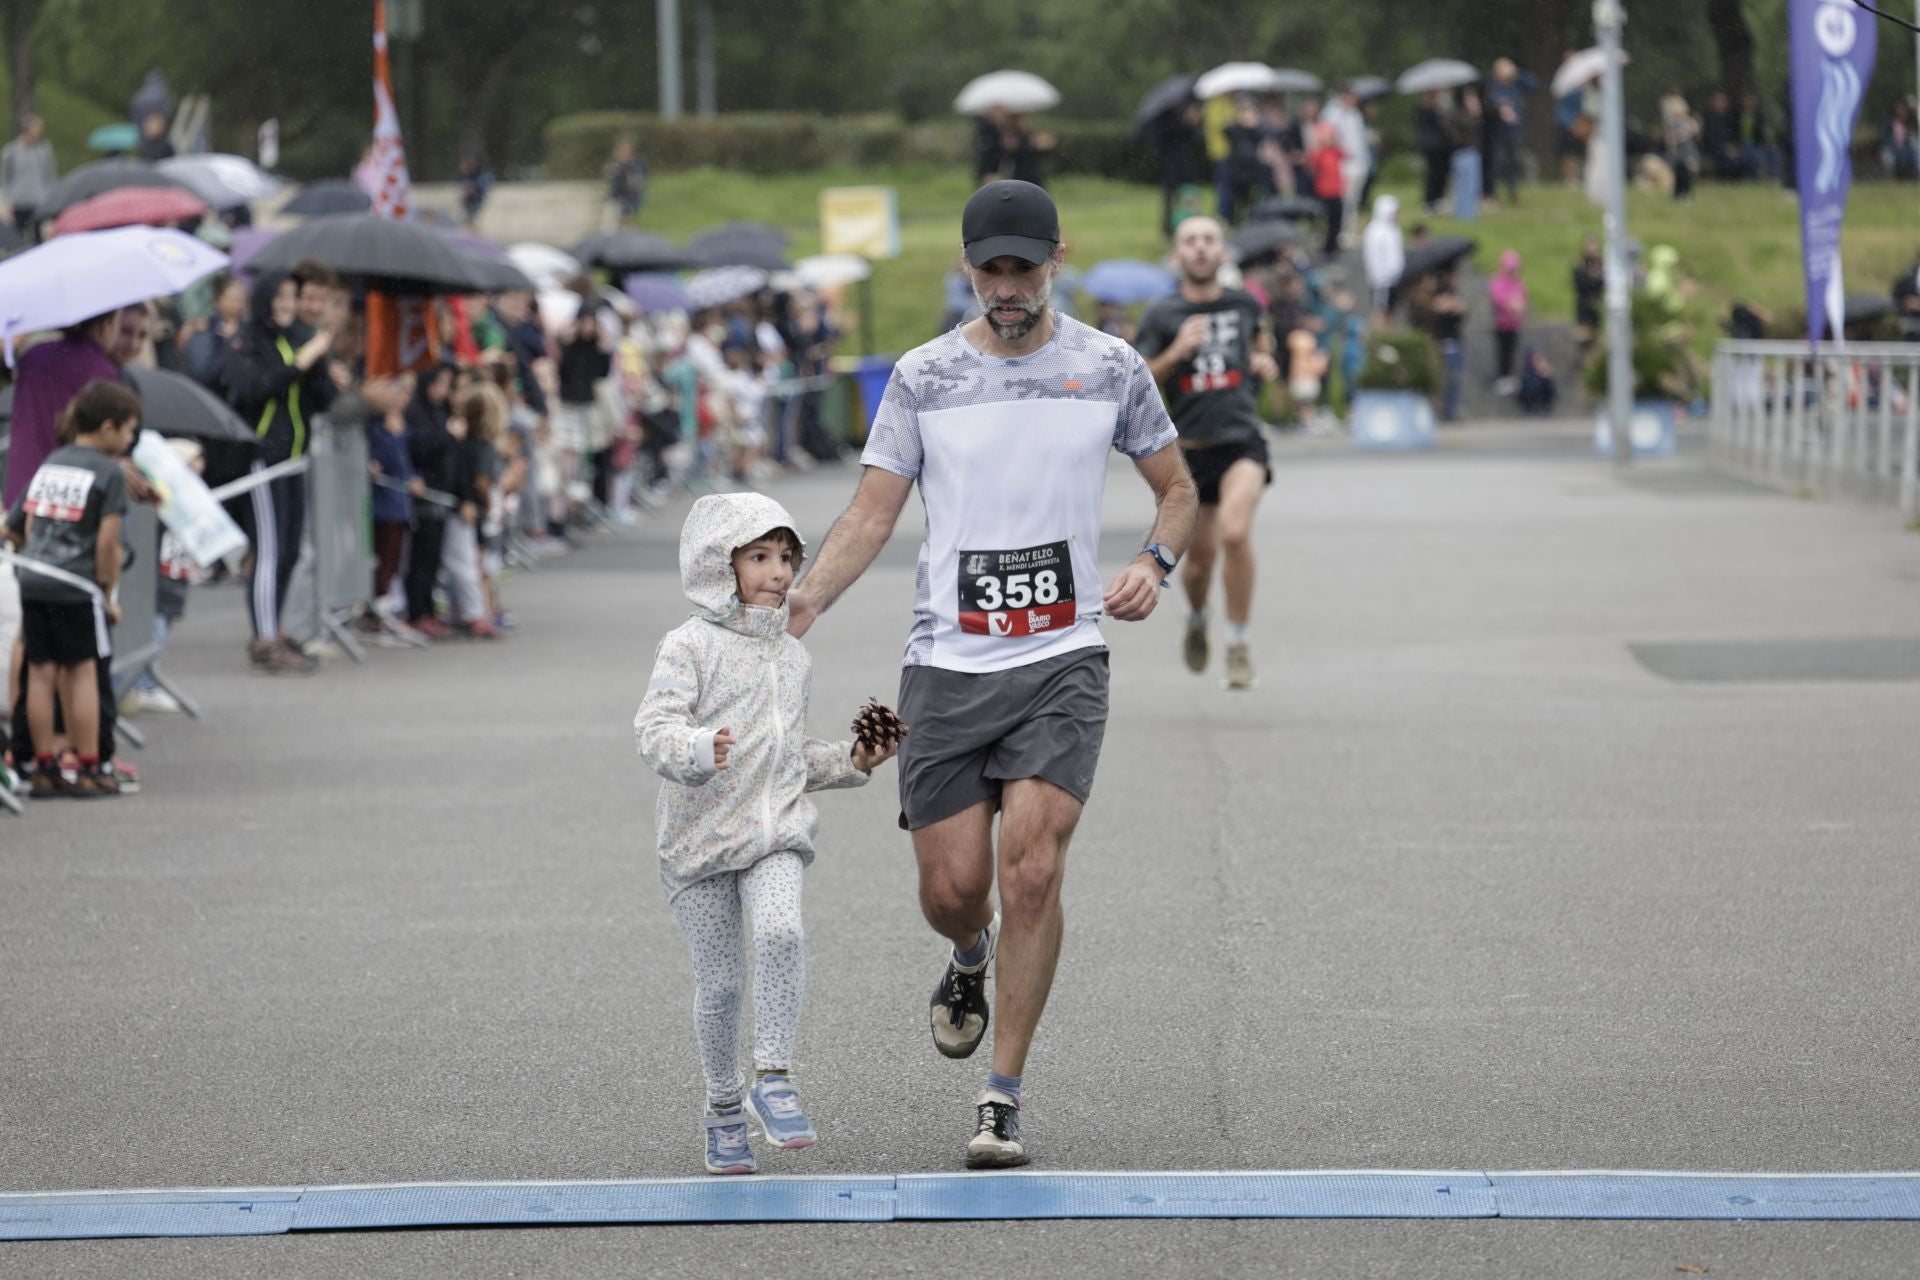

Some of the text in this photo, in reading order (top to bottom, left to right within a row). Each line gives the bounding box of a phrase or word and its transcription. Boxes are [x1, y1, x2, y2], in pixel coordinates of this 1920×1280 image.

[999, 548, 1053, 563] BEÑAT ELZO
[1006, 563, 1027, 571] MENDI
[975, 569, 1059, 611] 358
[1029, 615, 1051, 623] DIARIO
[1029, 621, 1050, 632] VASCO
